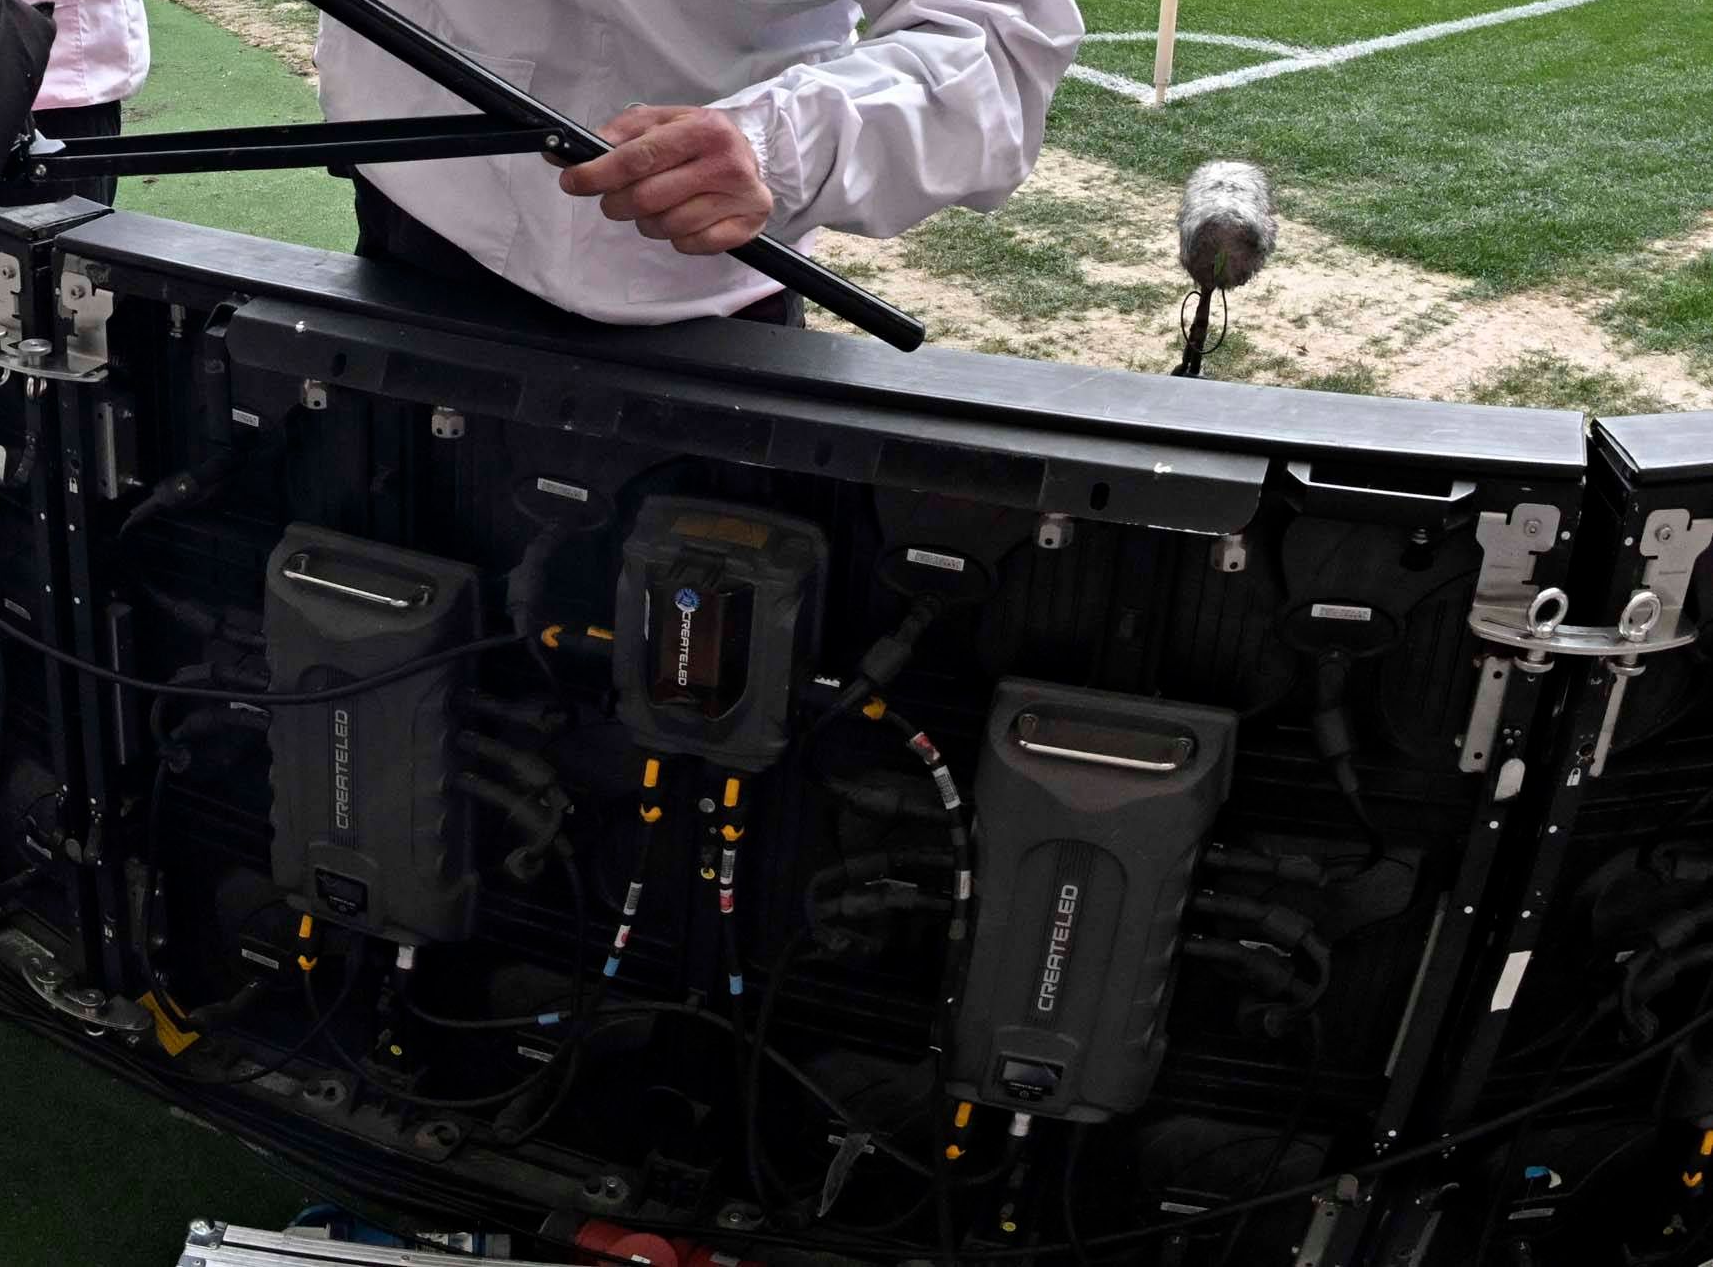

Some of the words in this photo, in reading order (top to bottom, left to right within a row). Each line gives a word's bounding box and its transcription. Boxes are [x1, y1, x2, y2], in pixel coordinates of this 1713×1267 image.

[678, 612, 692, 686] CREATELED
[335, 709, 349, 830] CREATELED
[1037, 884, 1079, 1011] CREATELED
